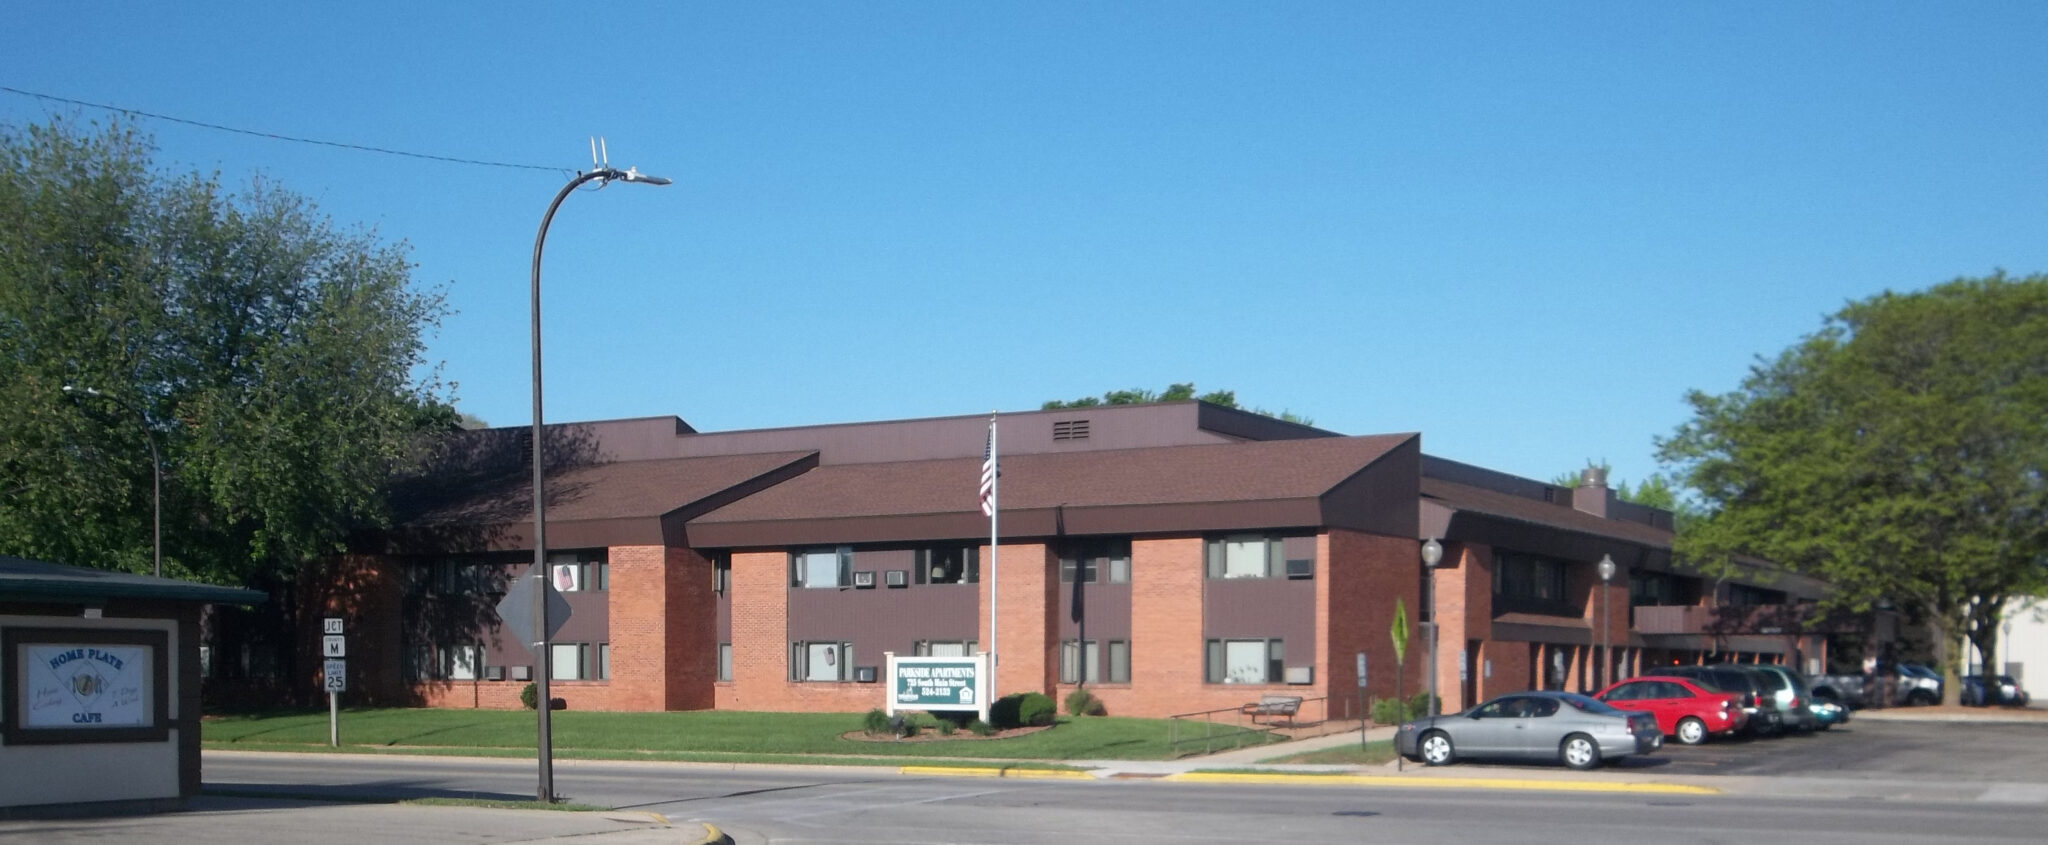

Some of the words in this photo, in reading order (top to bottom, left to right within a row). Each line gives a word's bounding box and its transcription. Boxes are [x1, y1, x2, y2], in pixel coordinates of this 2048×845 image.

[326, 620, 342, 632] JCT
[331, 643, 339, 654] M
[49, 649, 84, 670] HOME
[88, 648, 124, 670] PLATE
[899, 667, 930, 678] PARKSIDE
[931, 667, 974, 678] APARTMENTS
[328, 676, 343, 688] 25
[949, 678, 966, 687] Street
[72, 713, 102, 724] CAFE
